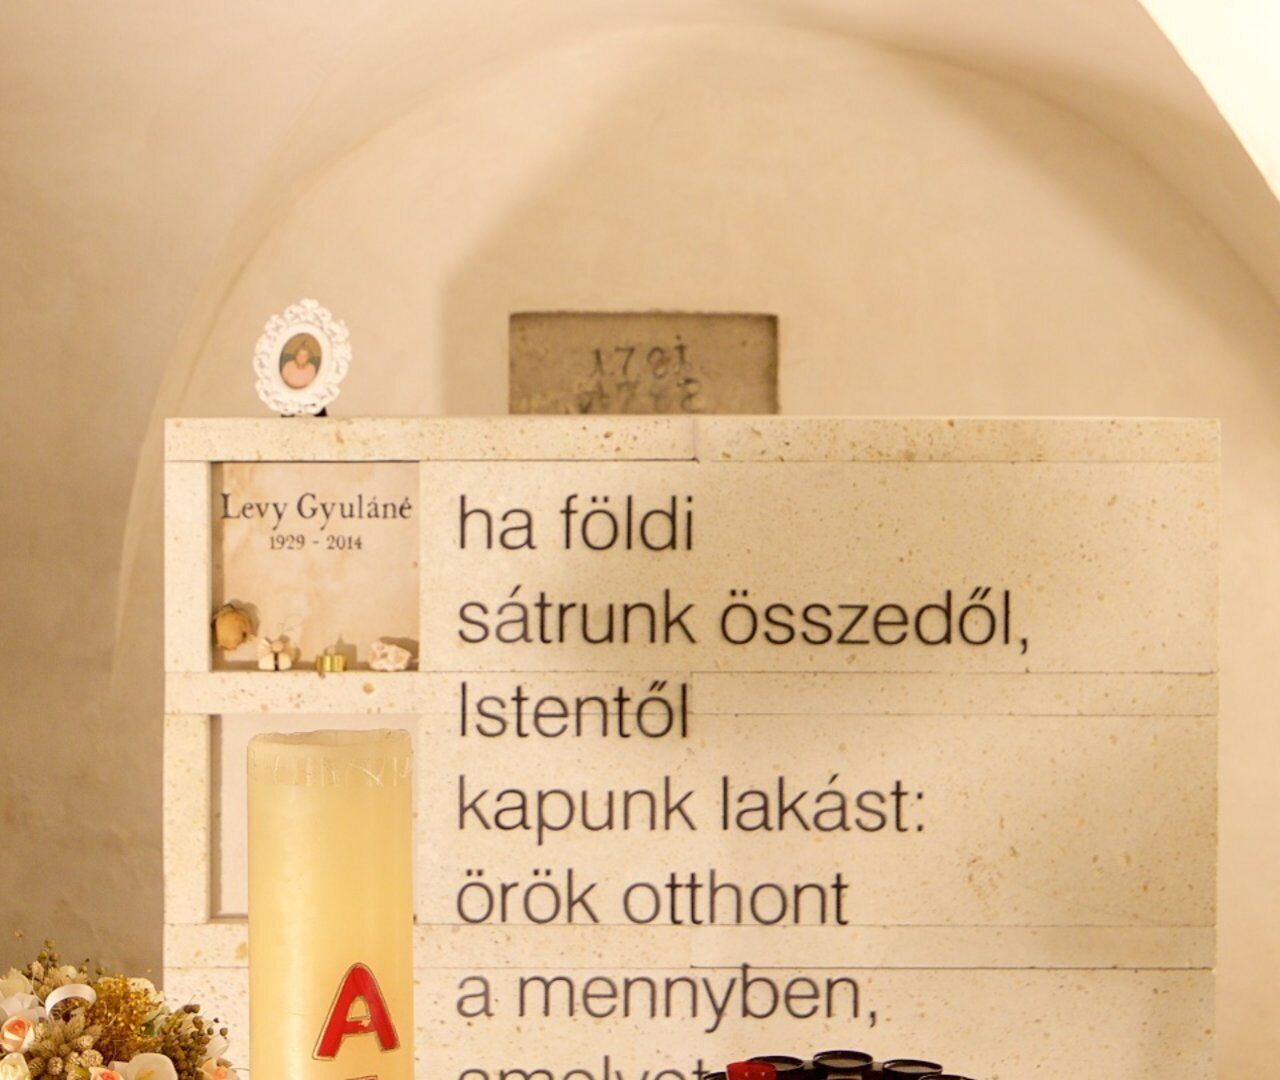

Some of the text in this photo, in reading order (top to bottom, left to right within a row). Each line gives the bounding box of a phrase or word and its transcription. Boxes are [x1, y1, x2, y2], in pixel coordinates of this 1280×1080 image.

[220, 491, 413, 531] Levy Gyuláné
[458, 493, 694, 553] ha földi
[269, 534, 306, 550] 1929
[326, 534, 363, 550] 2014
[457, 583, 1029, 656] sátrunk összedől,
[459, 679, 695, 740] Istentől
[457, 772, 926, 847] kapunk lakást:
[456, 867, 851, 926] örök otthont
[456, 965, 878, 1035] a mennyben,
